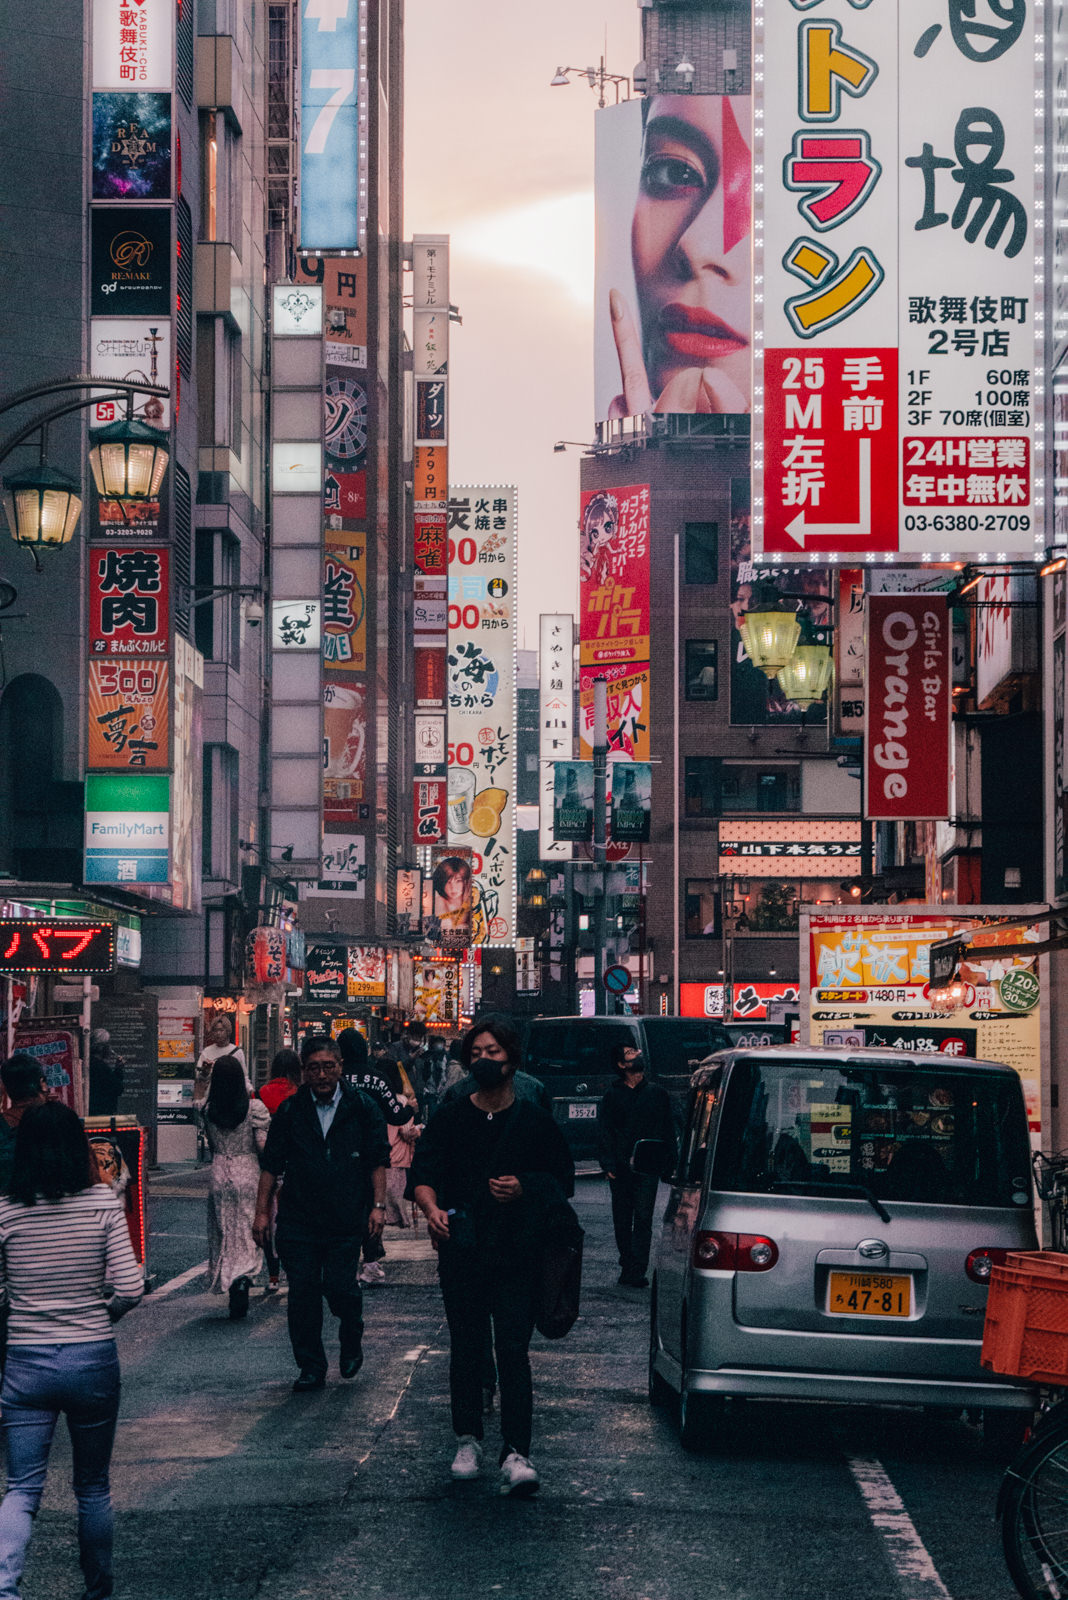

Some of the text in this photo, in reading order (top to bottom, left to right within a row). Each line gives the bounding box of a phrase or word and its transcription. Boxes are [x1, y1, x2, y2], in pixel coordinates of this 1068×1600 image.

[119, 10, 138, 81] 歌舞伎町
[139, 9, 148, 81] KABUKI-CHO
[782, 0, 885, 339] トラン
[426, 248, 437, 305] 第一モナミビル
[909, 296, 1030, 324] 歌舞伎町
[927, 329, 1011, 358] 2号店
[841, 355, 885, 431] 手前
[907, 369, 1031, 387] 1F 60席
[97, 403, 115, 420] 5F
[427, 383, 444, 428] ダーツ
[907, 390, 1031, 408] 2F 100席
[907, 409, 1031, 428] 3F 70席(個室)
[906, 439, 1027, 469] 24H営業
[424, 446, 437, 499] 299円
[905, 474, 1027, 504] 年中無休
[617, 499, 631, 577] ガールズバー
[628, 495, 639, 558] コンカフェ
[637, 488, 649, 558] キャバクラ
[904, 515, 1031, 532] 03-6380-2709
[416, 525, 445, 568] 麻雀
[98, 551, 161, 634] 焼肉
[95, 640, 106, 651] 2F
[99, 663, 158, 696] 300
[921, 611, 943, 722] Girls Bar
[872, 610, 919, 800] Orange
[606, 716, 647, 751] イト
[423, 764, 437, 774] 3F
[91, 822, 164, 838] FamilyMart
[559, 819, 586, 828] IMPACT
[616, 821, 645, 829] IMPACT
[117, 859, 138, 881] 酒
[943, 1041, 964, 1056] 4F
[363, 1074, 400, 1113] STRIPES
[849, 1278, 893, 1290] 川崎 580
[847, 1290, 903, 1313] 47-81
